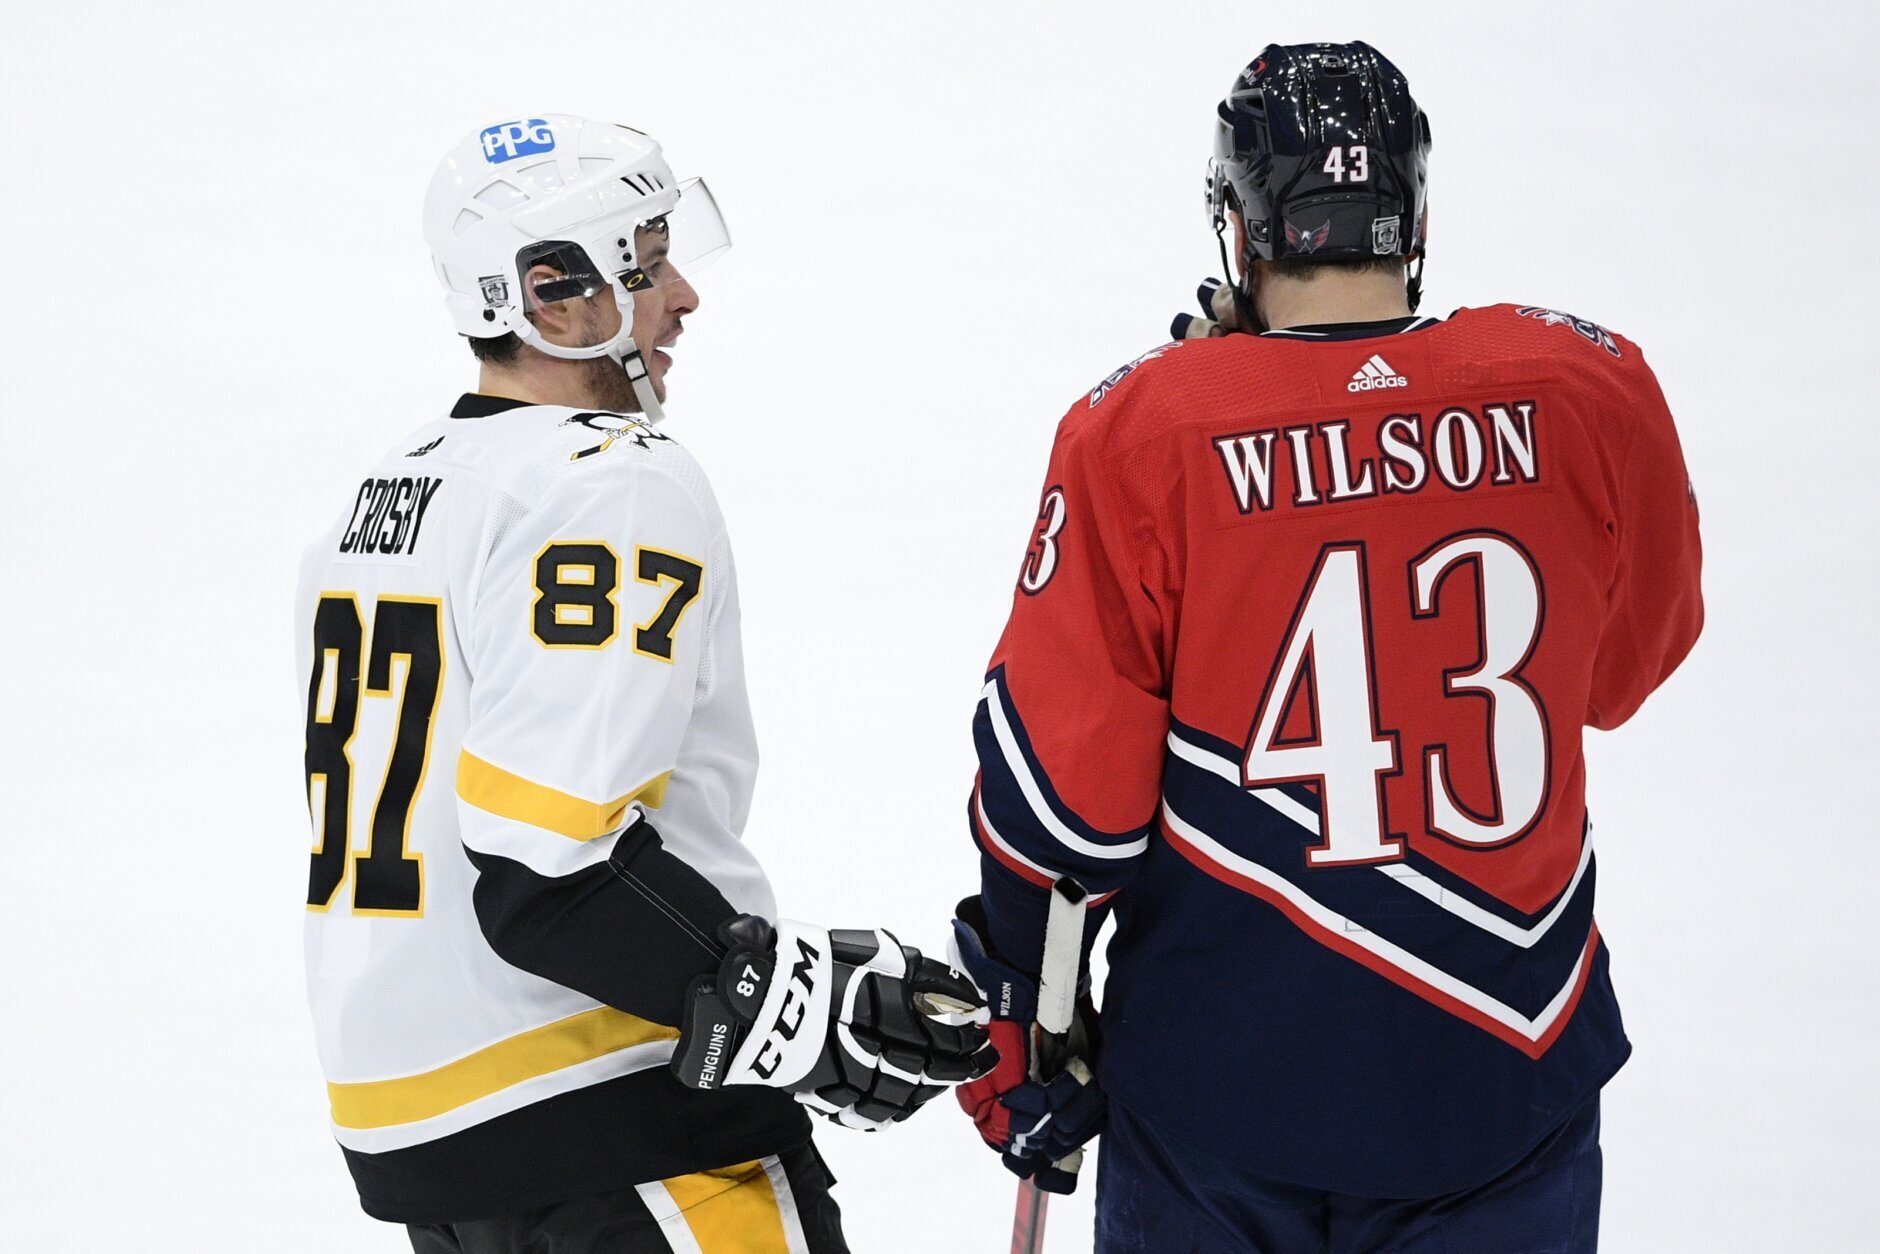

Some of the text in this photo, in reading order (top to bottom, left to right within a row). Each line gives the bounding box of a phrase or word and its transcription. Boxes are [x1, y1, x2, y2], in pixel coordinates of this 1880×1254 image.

[481, 121, 555, 158] PPG
[1323, 146, 1369, 183] 43
[1347, 376, 1408, 392] adidas
[1213, 400, 1541, 513] WILSON
[339, 476, 443, 556] CROSBY
[529, 539, 704, 664] 87
[1243, 529, 1552, 868] 43
[305, 592, 446, 918] 87
[736, 964, 761, 998] 87
[748, 936, 820, 1081] CCM
[1000, 981, 1012, 1016] WILSON
[698, 1023, 728, 1089] PENGUINS
